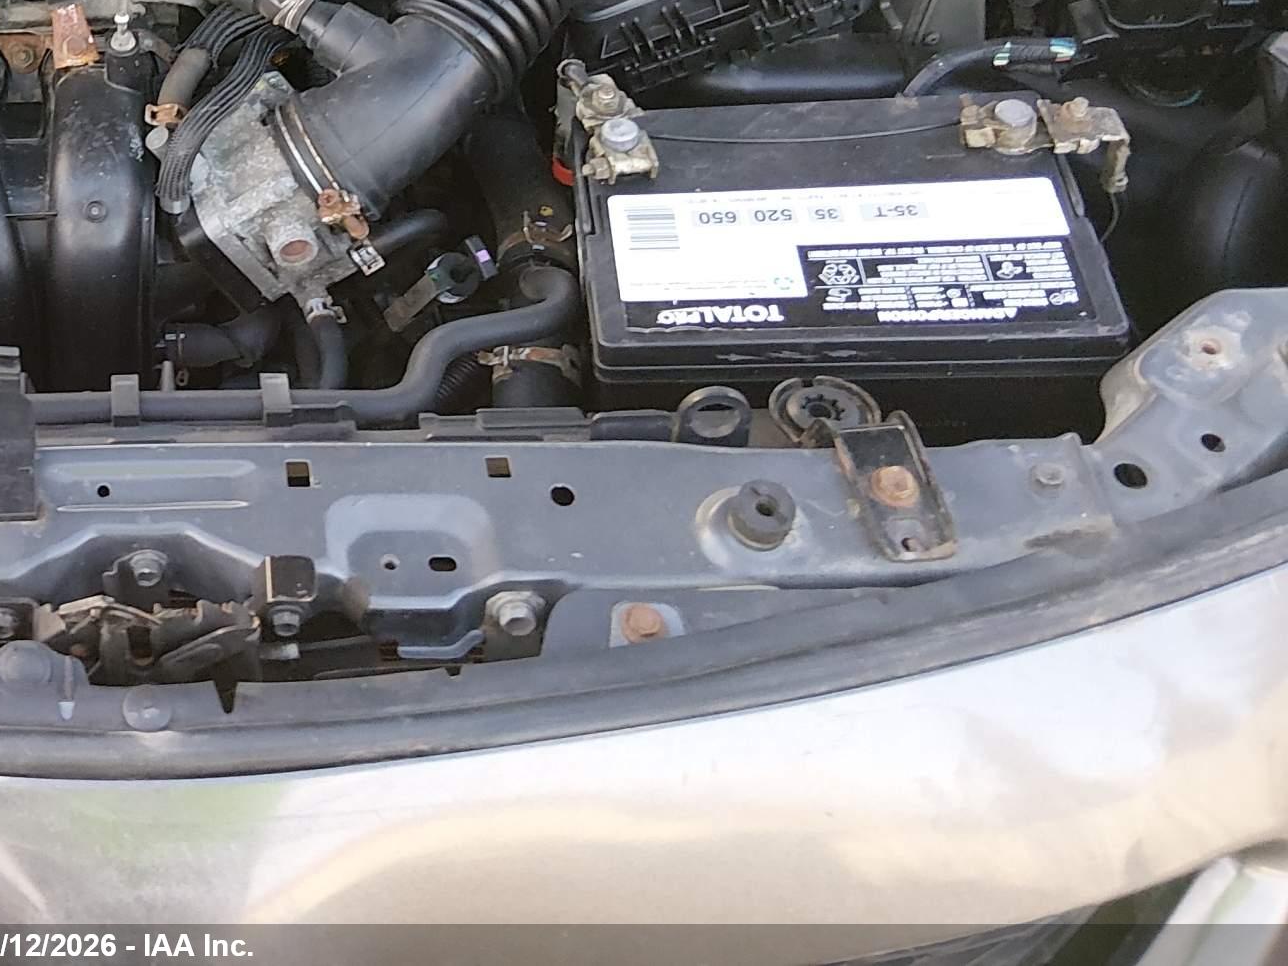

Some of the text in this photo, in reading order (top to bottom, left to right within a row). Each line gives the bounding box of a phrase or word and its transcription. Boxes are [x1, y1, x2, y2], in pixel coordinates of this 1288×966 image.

[698, 204, 920, 225] 35-T 35 520 650
